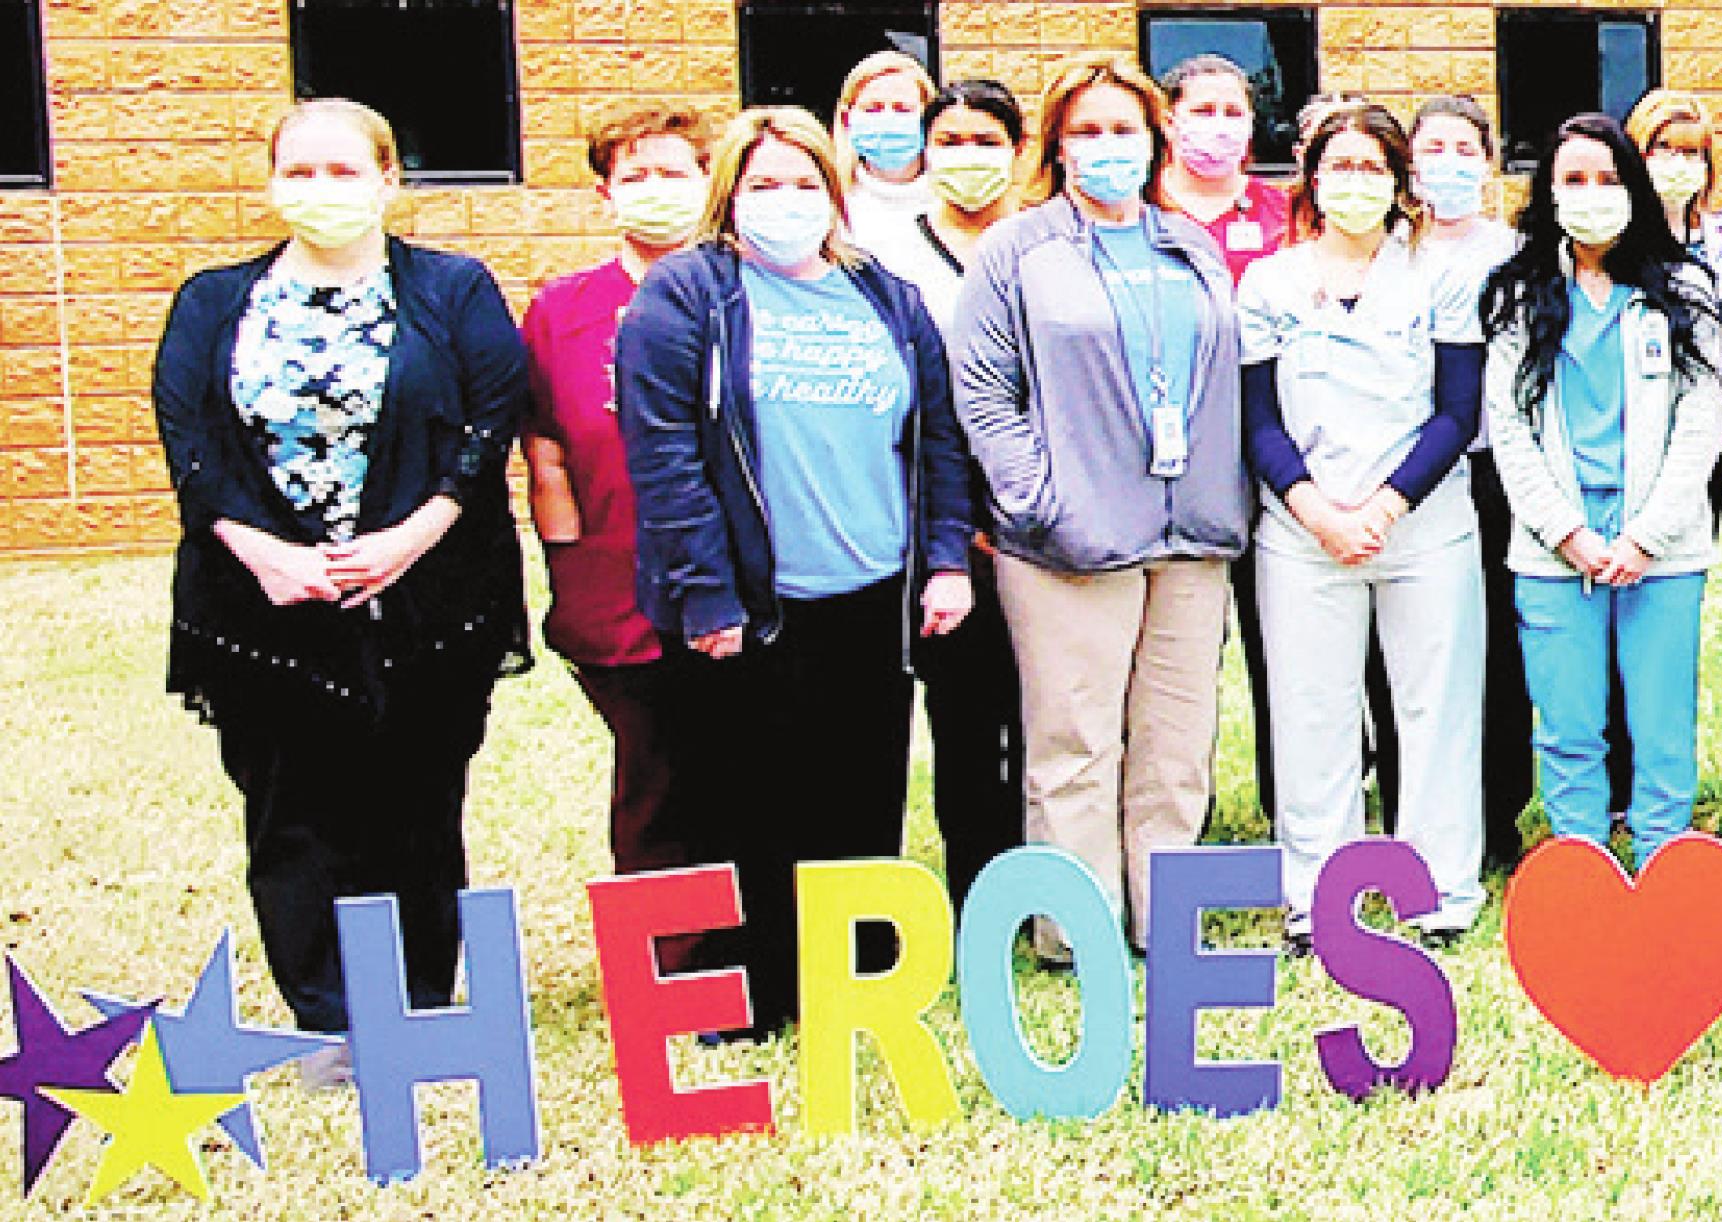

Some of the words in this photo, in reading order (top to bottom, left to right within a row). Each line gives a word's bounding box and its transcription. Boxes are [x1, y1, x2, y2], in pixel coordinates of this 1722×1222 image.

[781, 341, 890, 373] happy
[768, 374, 898, 416] healthy
[333, 835, 1459, 1187] HEROES
